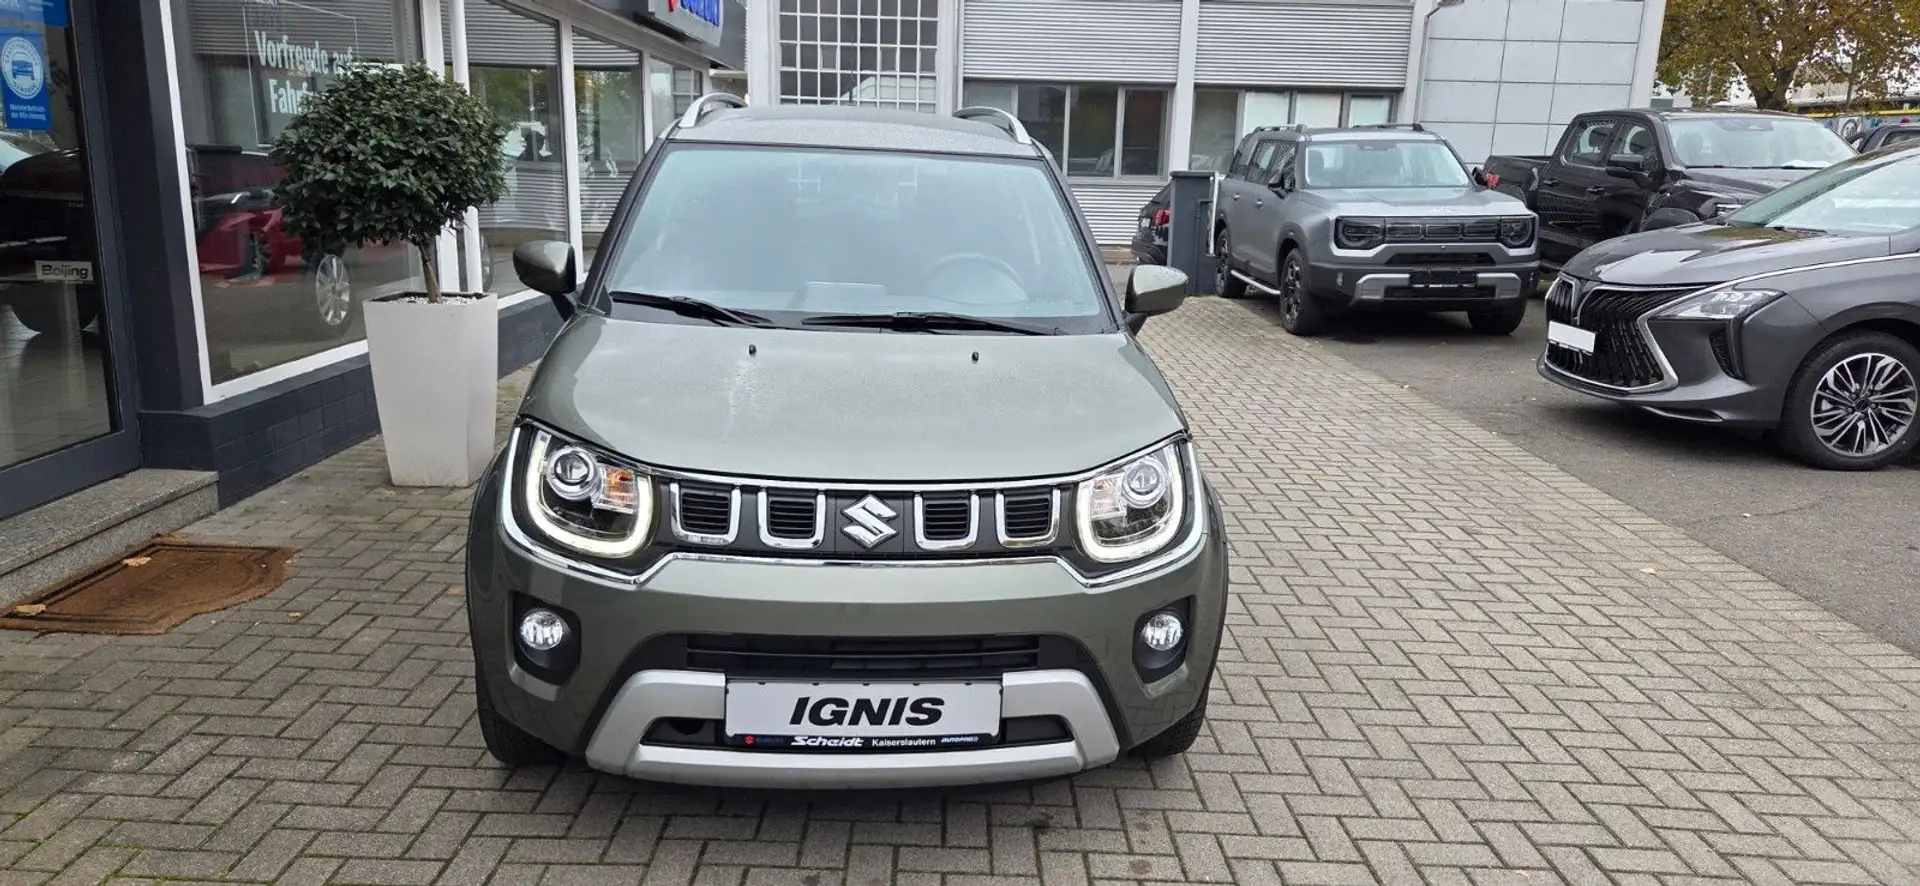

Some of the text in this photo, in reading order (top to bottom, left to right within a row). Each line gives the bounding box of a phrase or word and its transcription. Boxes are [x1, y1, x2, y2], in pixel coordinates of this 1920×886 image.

[254, 30, 328, 75] Vorfreude
[41, 264, 89, 279] Beijing
[789, 697, 945, 726] IGNIS
[790, 736, 864, 747] Scheidt
[872, 738, 936, 747] Kaiserslautern
